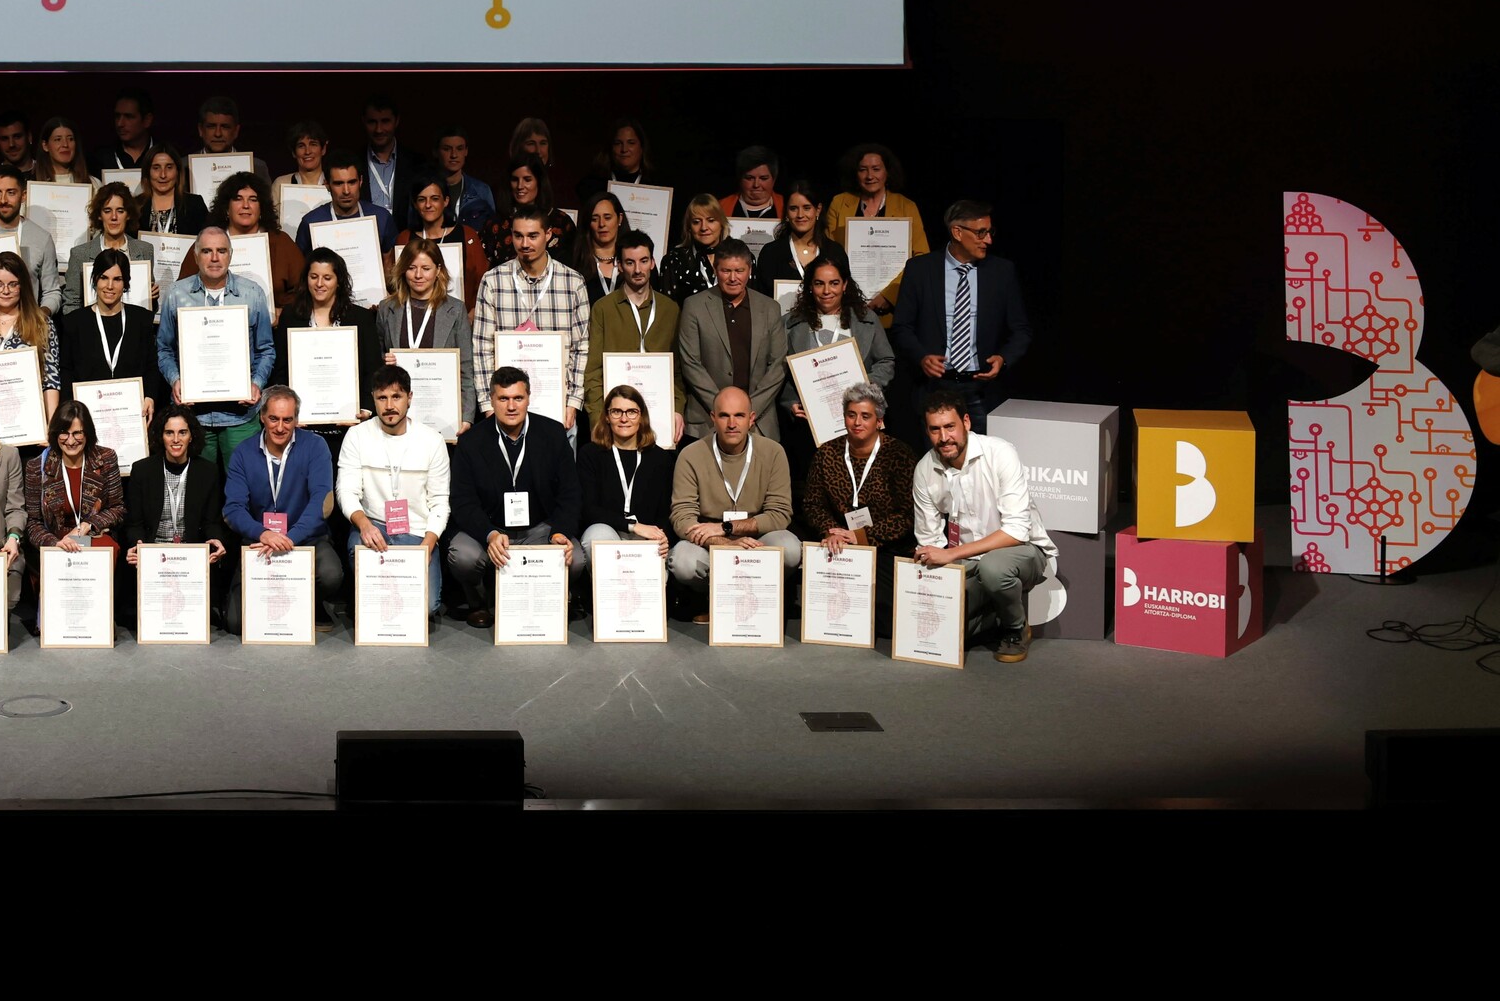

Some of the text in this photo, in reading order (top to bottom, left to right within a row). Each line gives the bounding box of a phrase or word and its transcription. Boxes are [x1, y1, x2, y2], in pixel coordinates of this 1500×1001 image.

[1144, 586, 1225, 610] HARROBI
[1144, 603, 1180, 612] EUSKARAREN
[1144, 609, 1196, 620] AITORTZA-DIPLOMA
